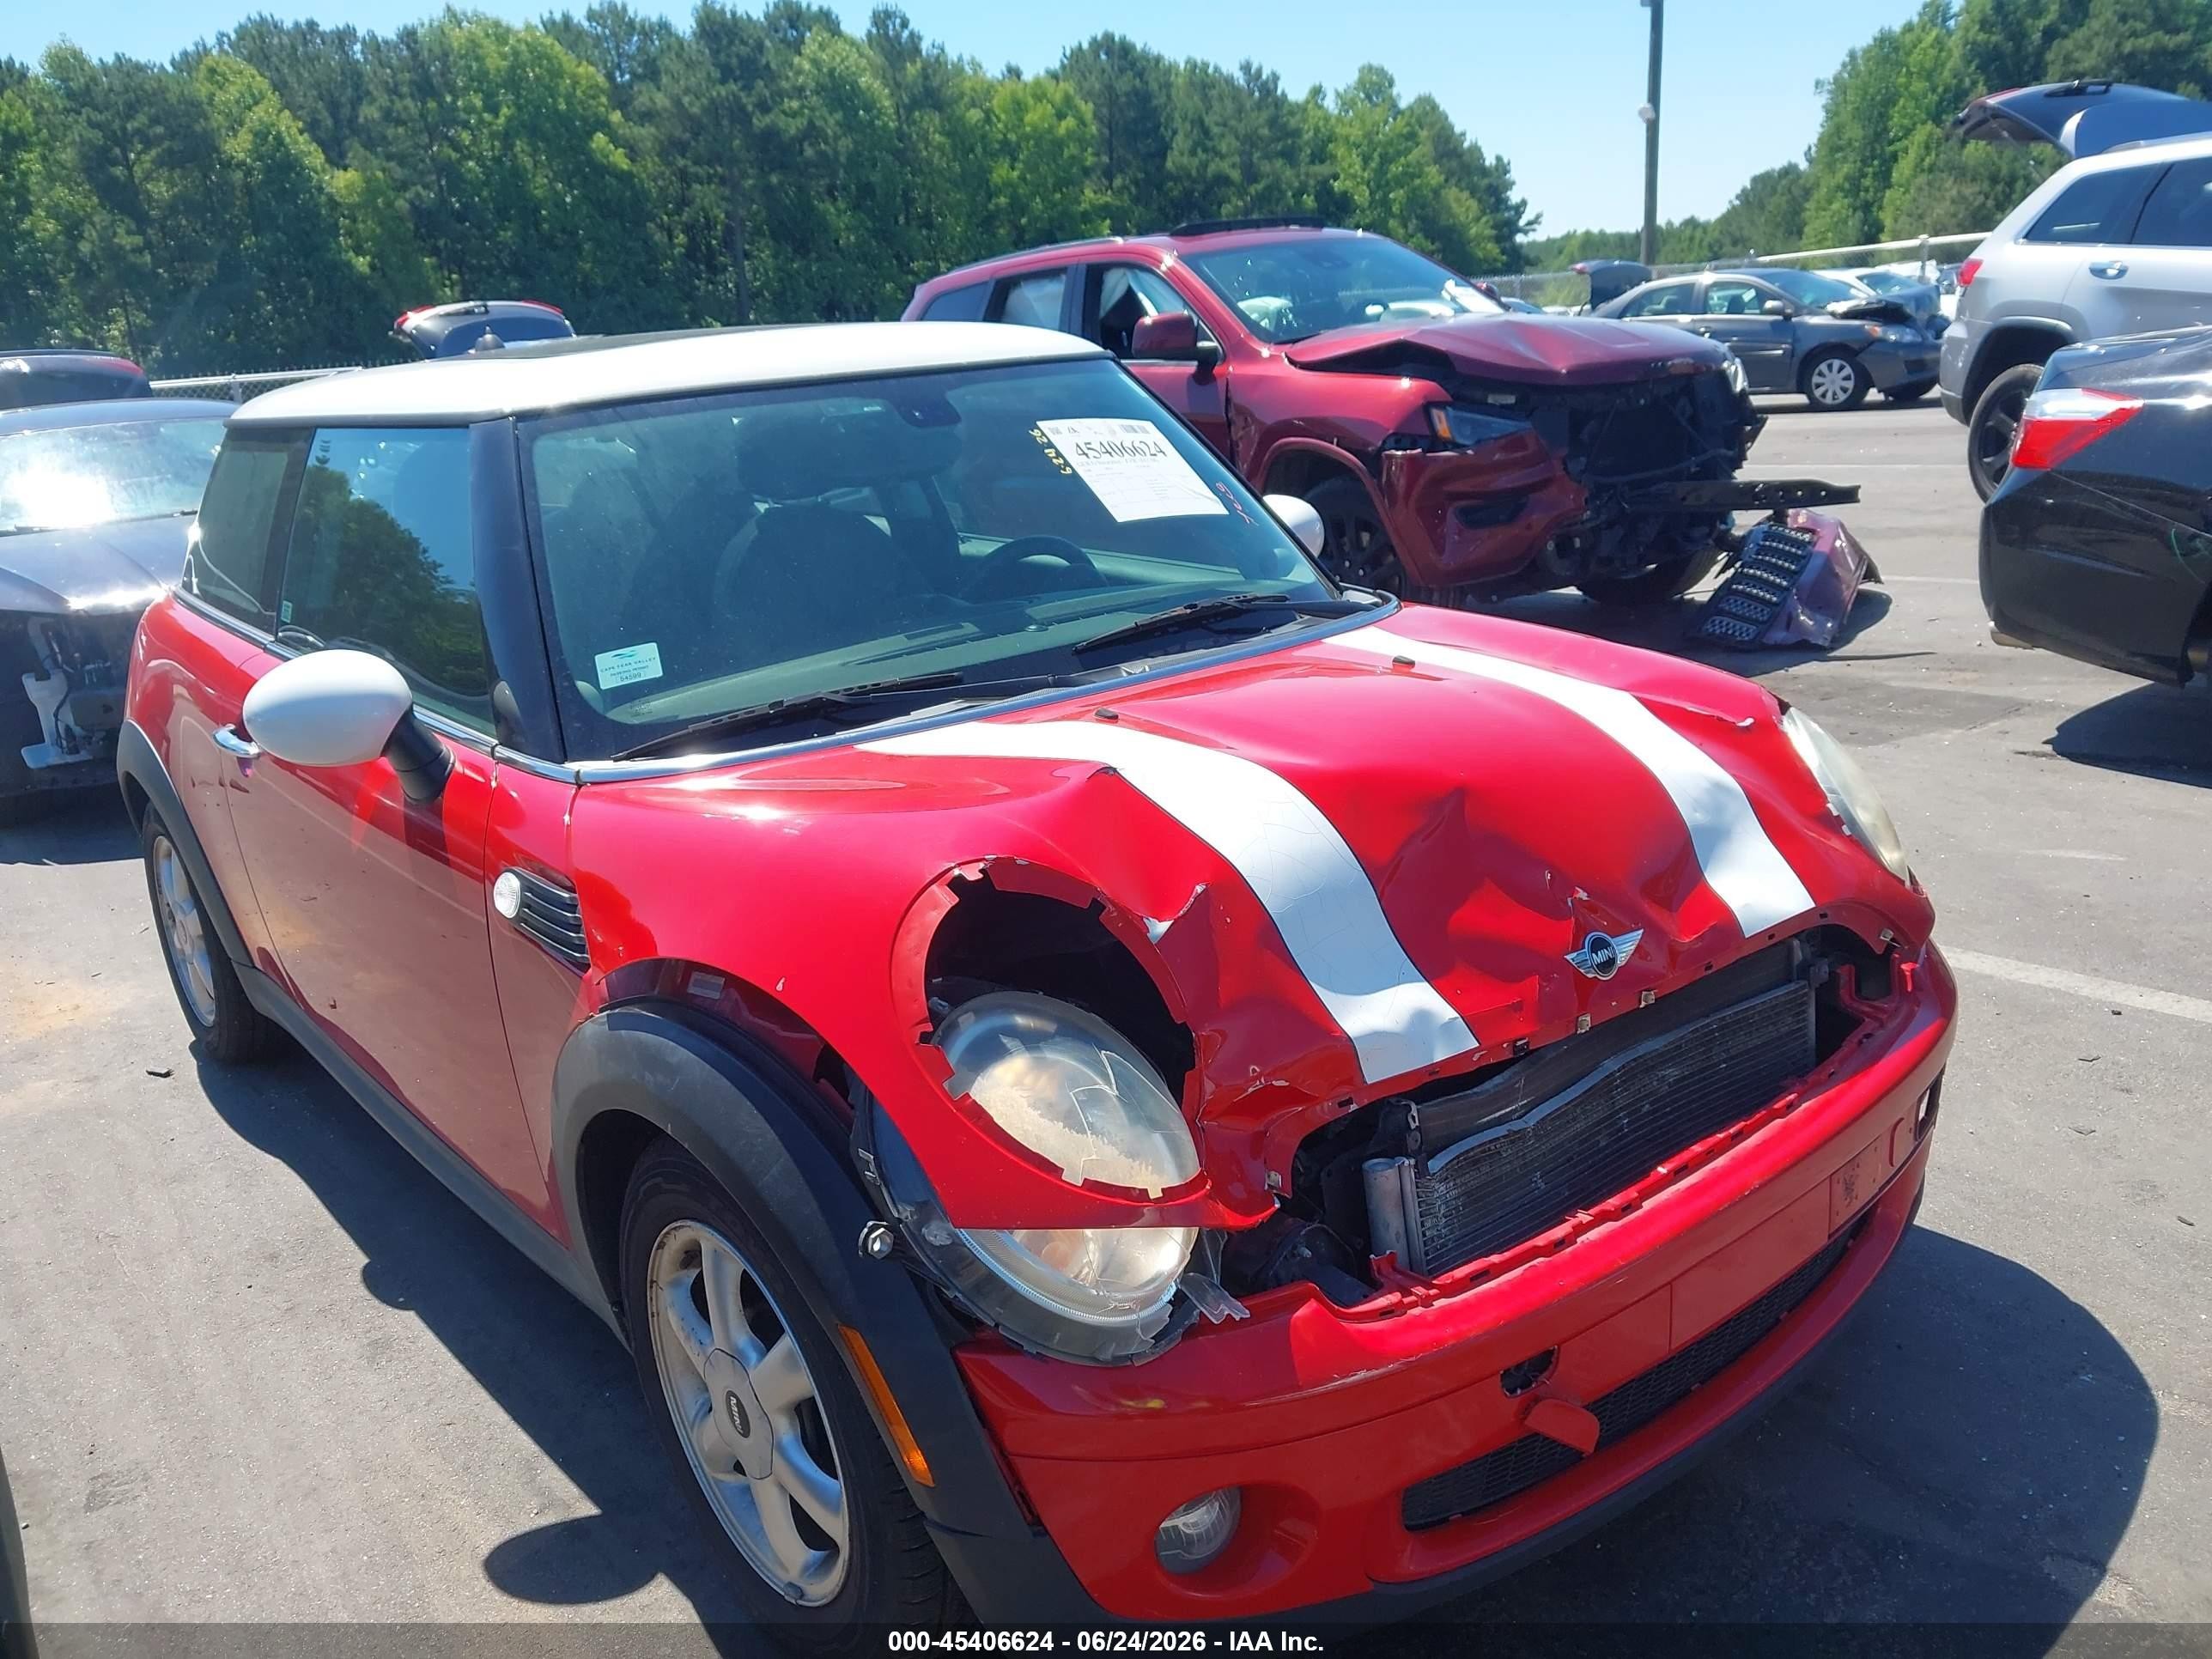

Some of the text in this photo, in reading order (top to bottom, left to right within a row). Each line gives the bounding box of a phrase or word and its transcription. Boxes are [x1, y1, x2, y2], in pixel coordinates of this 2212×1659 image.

[1075, 440, 1167, 459] 45406624
[1591, 946, 1615, 965] MINI
[729, 1396, 744, 1434] MINI
